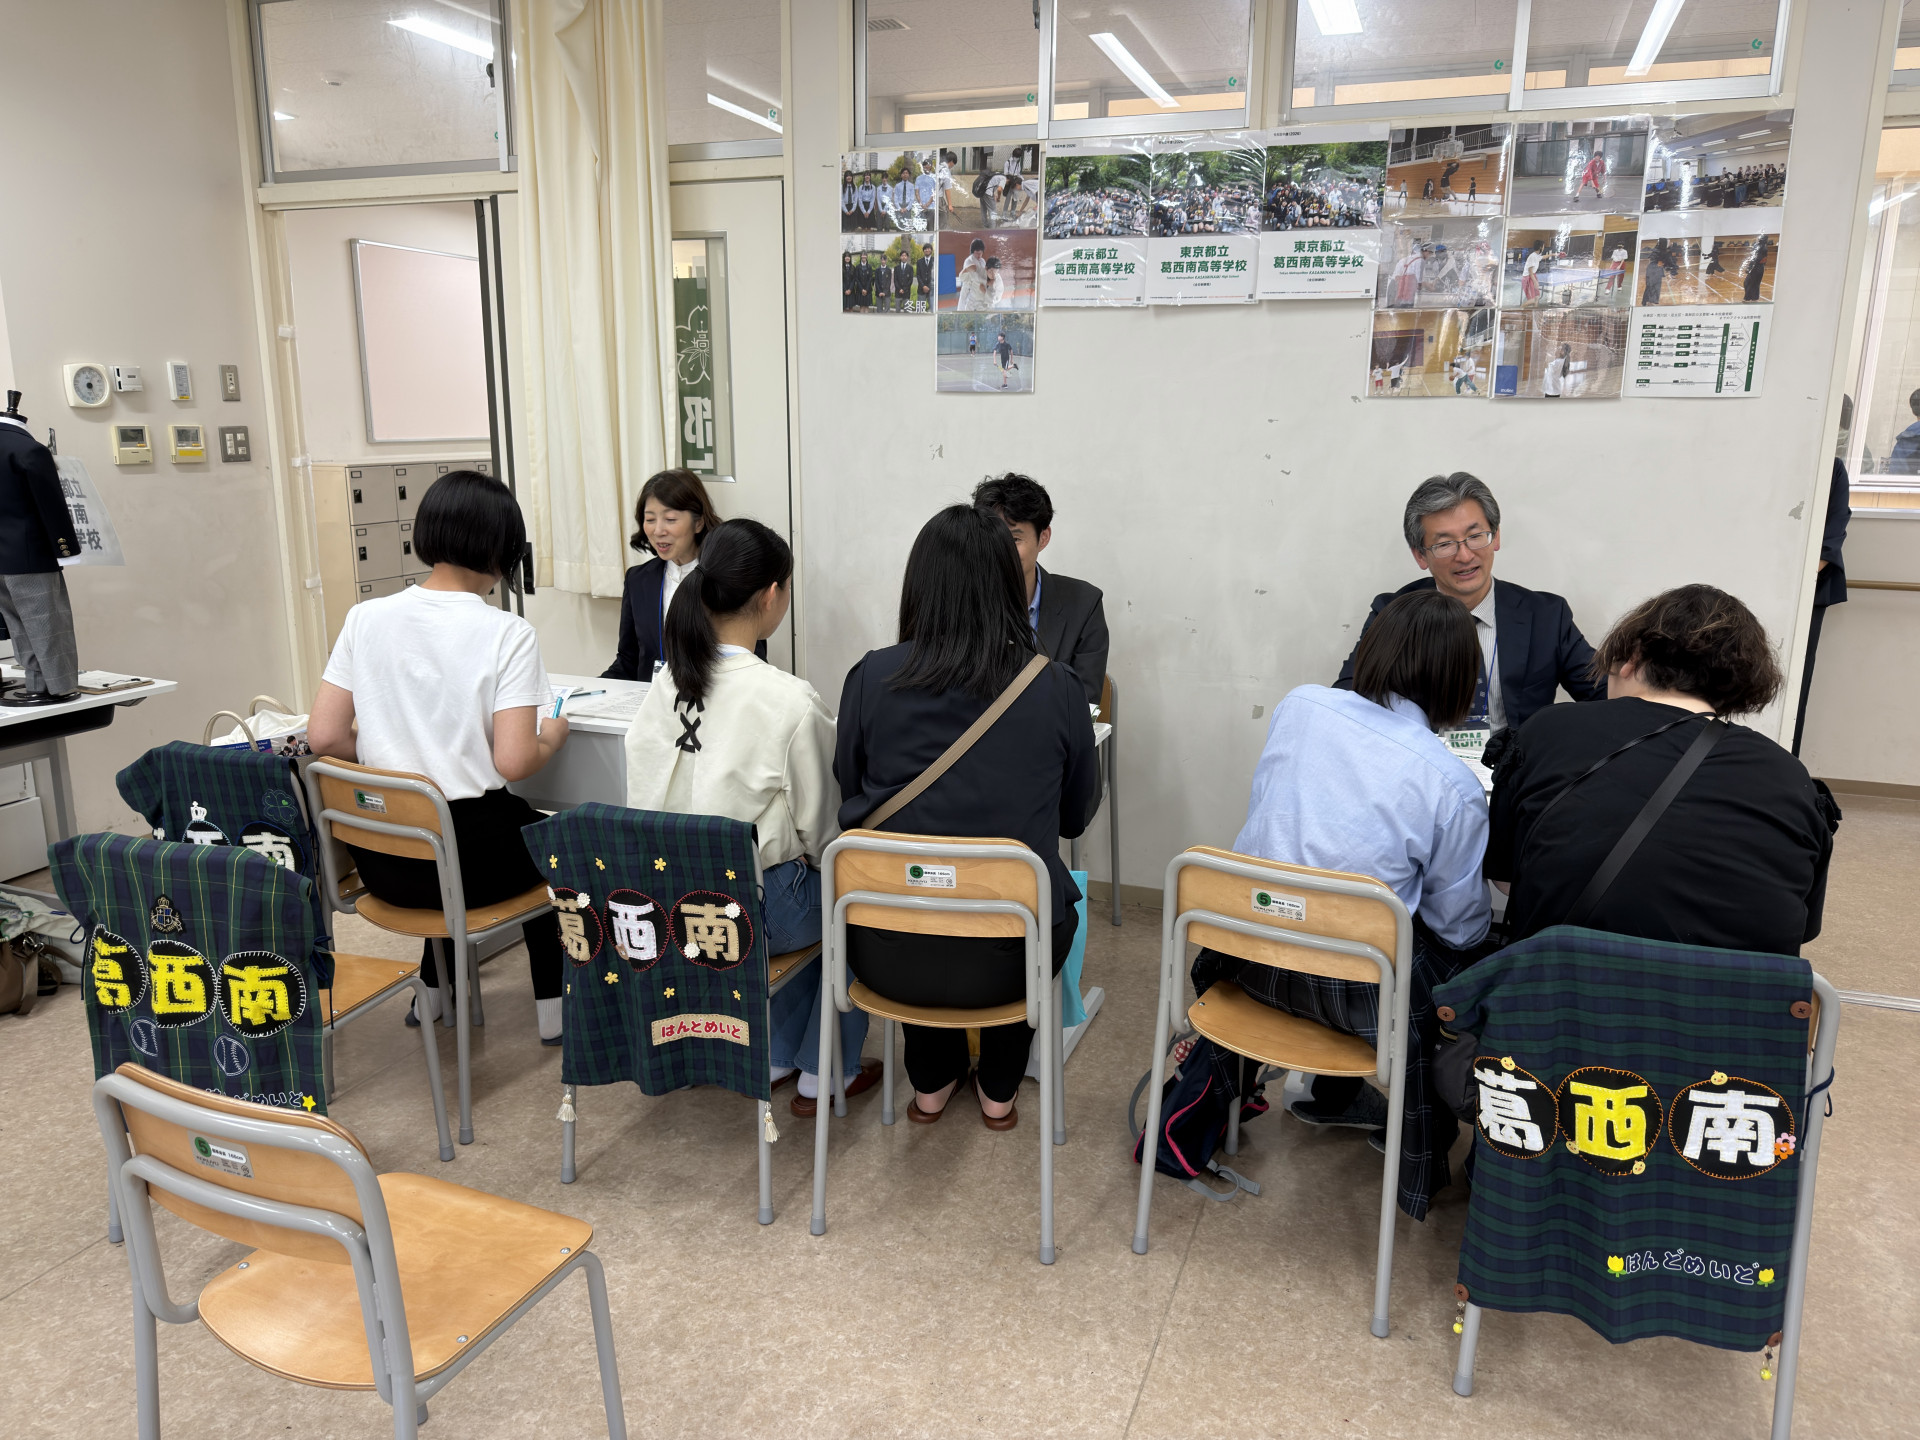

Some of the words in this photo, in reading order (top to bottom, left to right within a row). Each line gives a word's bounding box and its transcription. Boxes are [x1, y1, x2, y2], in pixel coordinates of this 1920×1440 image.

[1180, 245, 1229, 258] 東京都立
[1293, 239, 1345, 253] 東京都立
[1072, 248, 1118, 260] 東京都立
[1160, 260, 1247, 273] 葛西南高等学校
[1273, 255, 1364, 269] 葛西南高等学校
[1055, 263, 1135, 275] 葛西南高等学校
[904, 300, 927, 313] 冬服
[912, 867, 921, 877] 5
[1260, 894, 1268, 905] 5
[661, 1018, 744, 1039] はんどめいど
[1474, 1066, 1780, 1168] 葛西南
[198, 1139, 209, 1155] 5
[1625, 1247, 1761, 1286] はんどめいど
